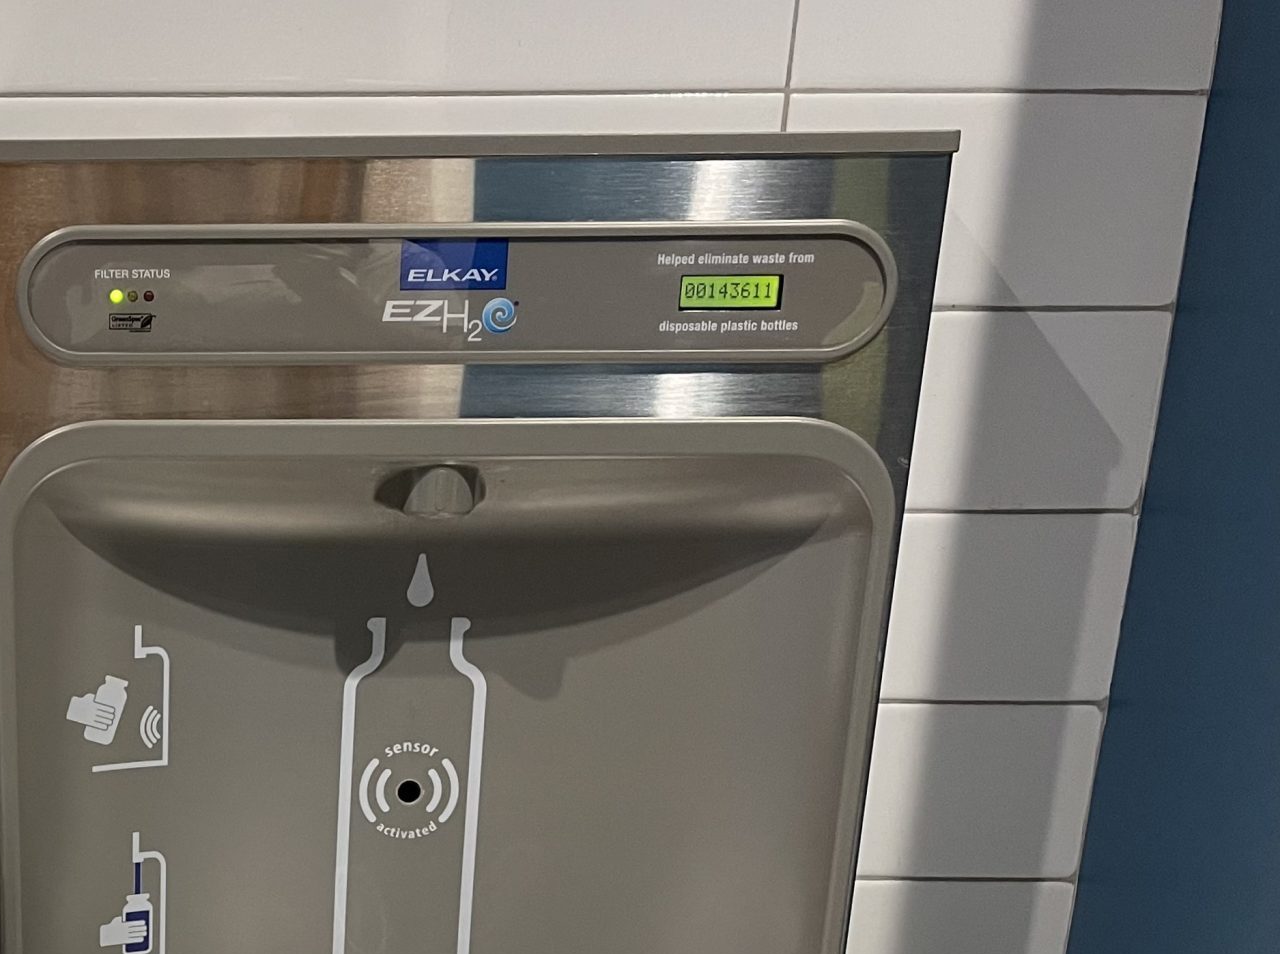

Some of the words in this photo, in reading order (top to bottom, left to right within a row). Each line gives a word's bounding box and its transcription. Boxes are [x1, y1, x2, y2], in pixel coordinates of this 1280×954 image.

[657, 253, 695, 267] Helped
[698, 252, 749, 265] eliminate
[752, 252, 785, 264] waste
[788, 252, 815, 264] from
[94, 269, 129, 279] FILTER
[131, 268, 171, 279] STATUS
[407, 268, 499, 282] ELKAY
[685, 282, 772, 299] 00143611
[658, 320, 718, 334] disposable
[720, 319, 758, 333] plastic
[760, 319, 799, 331] bottles
[384, 741, 439, 758] sensor
[376, 820, 438, 839] activated
